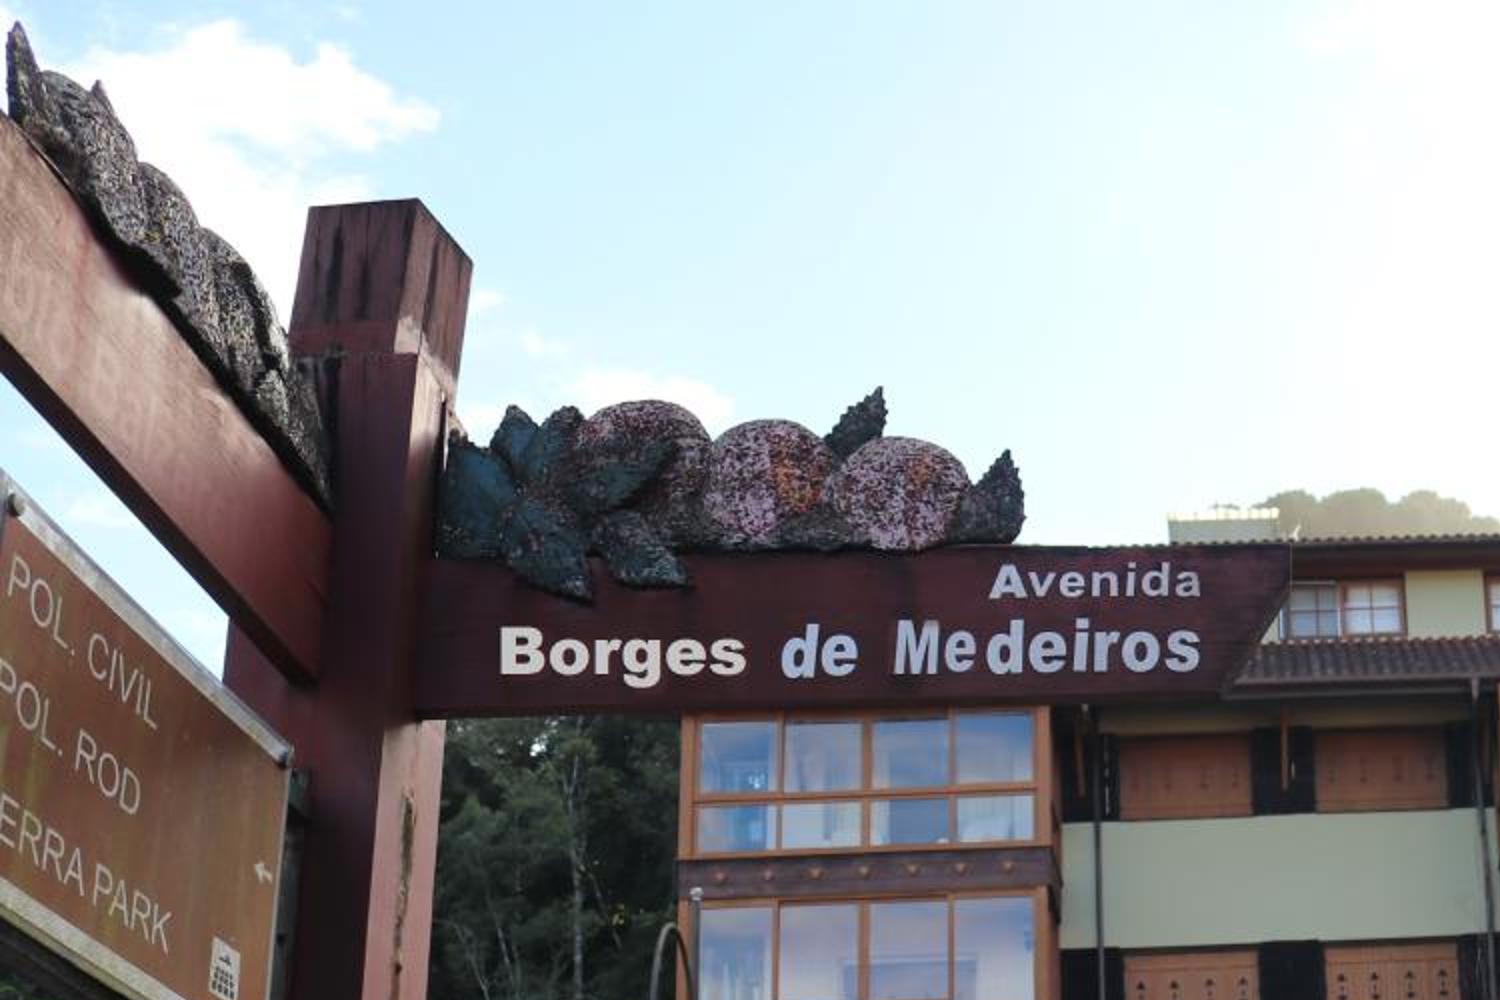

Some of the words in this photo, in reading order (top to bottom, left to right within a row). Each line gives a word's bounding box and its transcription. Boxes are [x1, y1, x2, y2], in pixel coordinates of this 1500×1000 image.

[988, 562, 1201, 599] Avenida
[6, 553, 76, 656] POL.
[87, 633, 158, 731] CIVIL
[500, 626, 747, 688] Borges
[781, 623, 858, 679] de
[894, 617, 1201, 675] Medeiros
[75, 729, 141, 815] ROD
[93, 863, 173, 955] PARK
